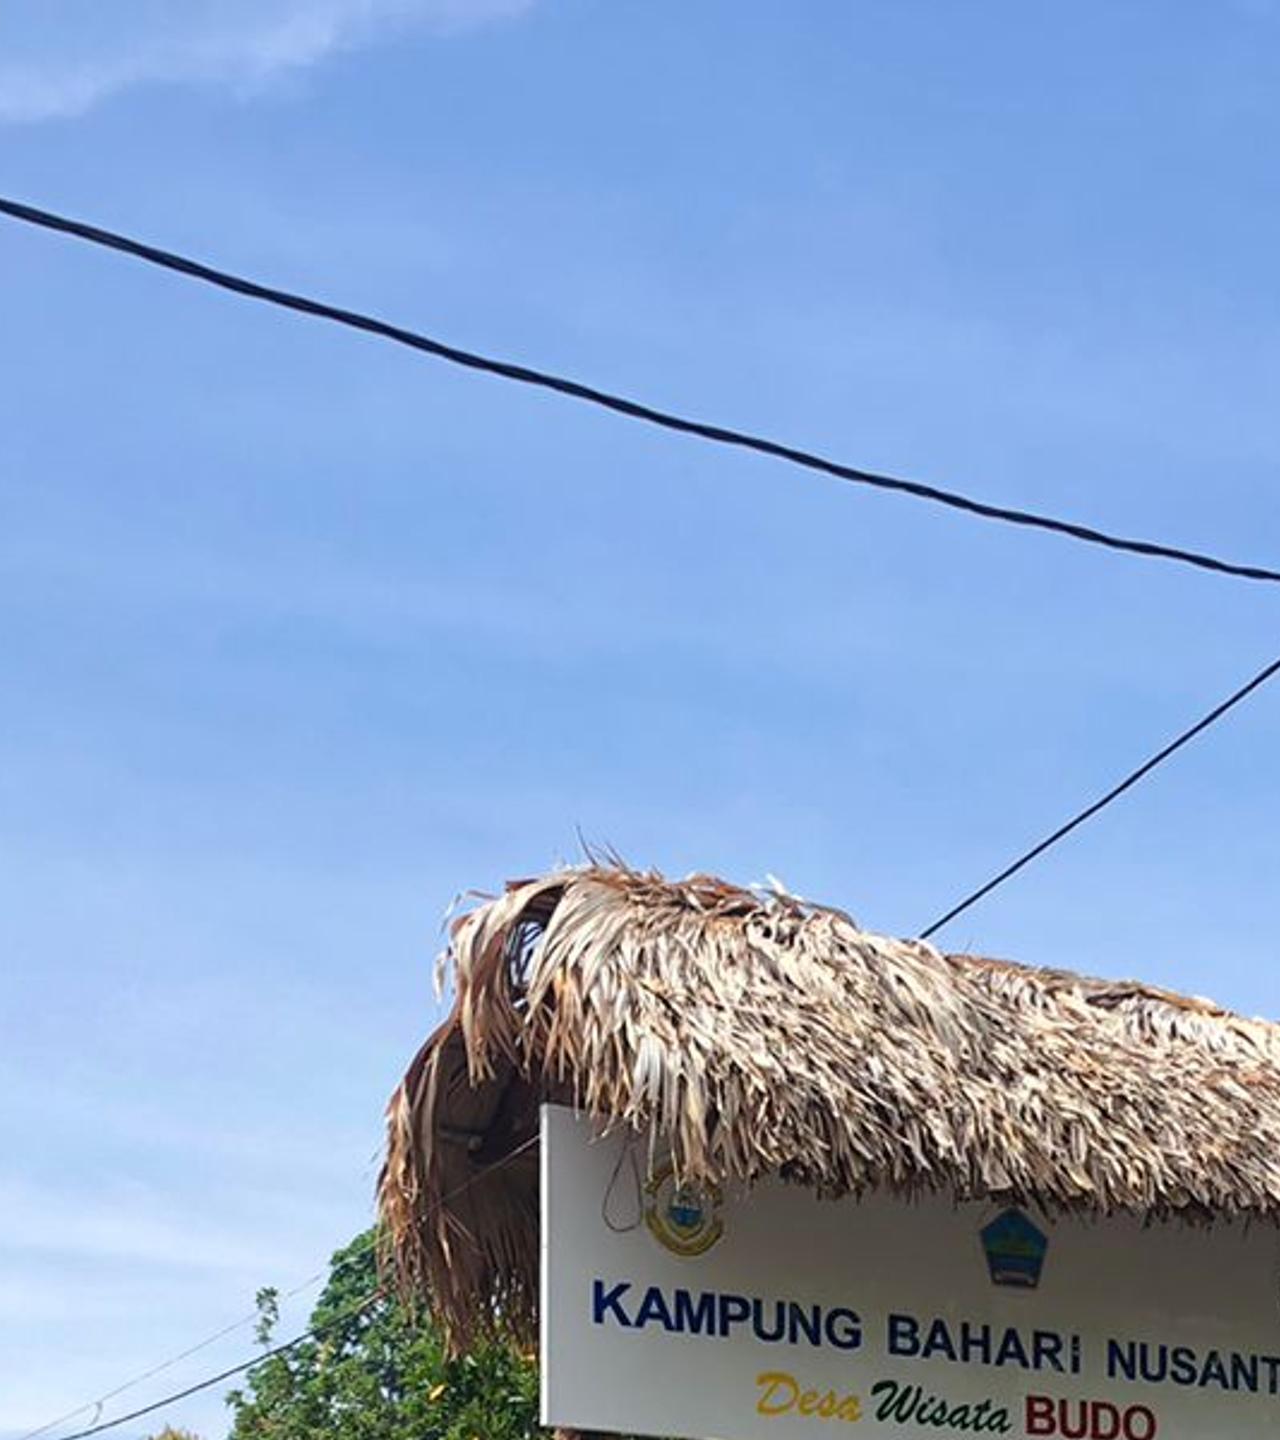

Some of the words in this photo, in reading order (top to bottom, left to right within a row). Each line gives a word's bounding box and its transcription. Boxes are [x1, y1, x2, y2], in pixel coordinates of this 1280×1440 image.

[591, 1279, 862, 1350] KAMPUNG
[755, 1371, 863, 1422] Desa
[870, 1379, 1013, 1434] Wisata
